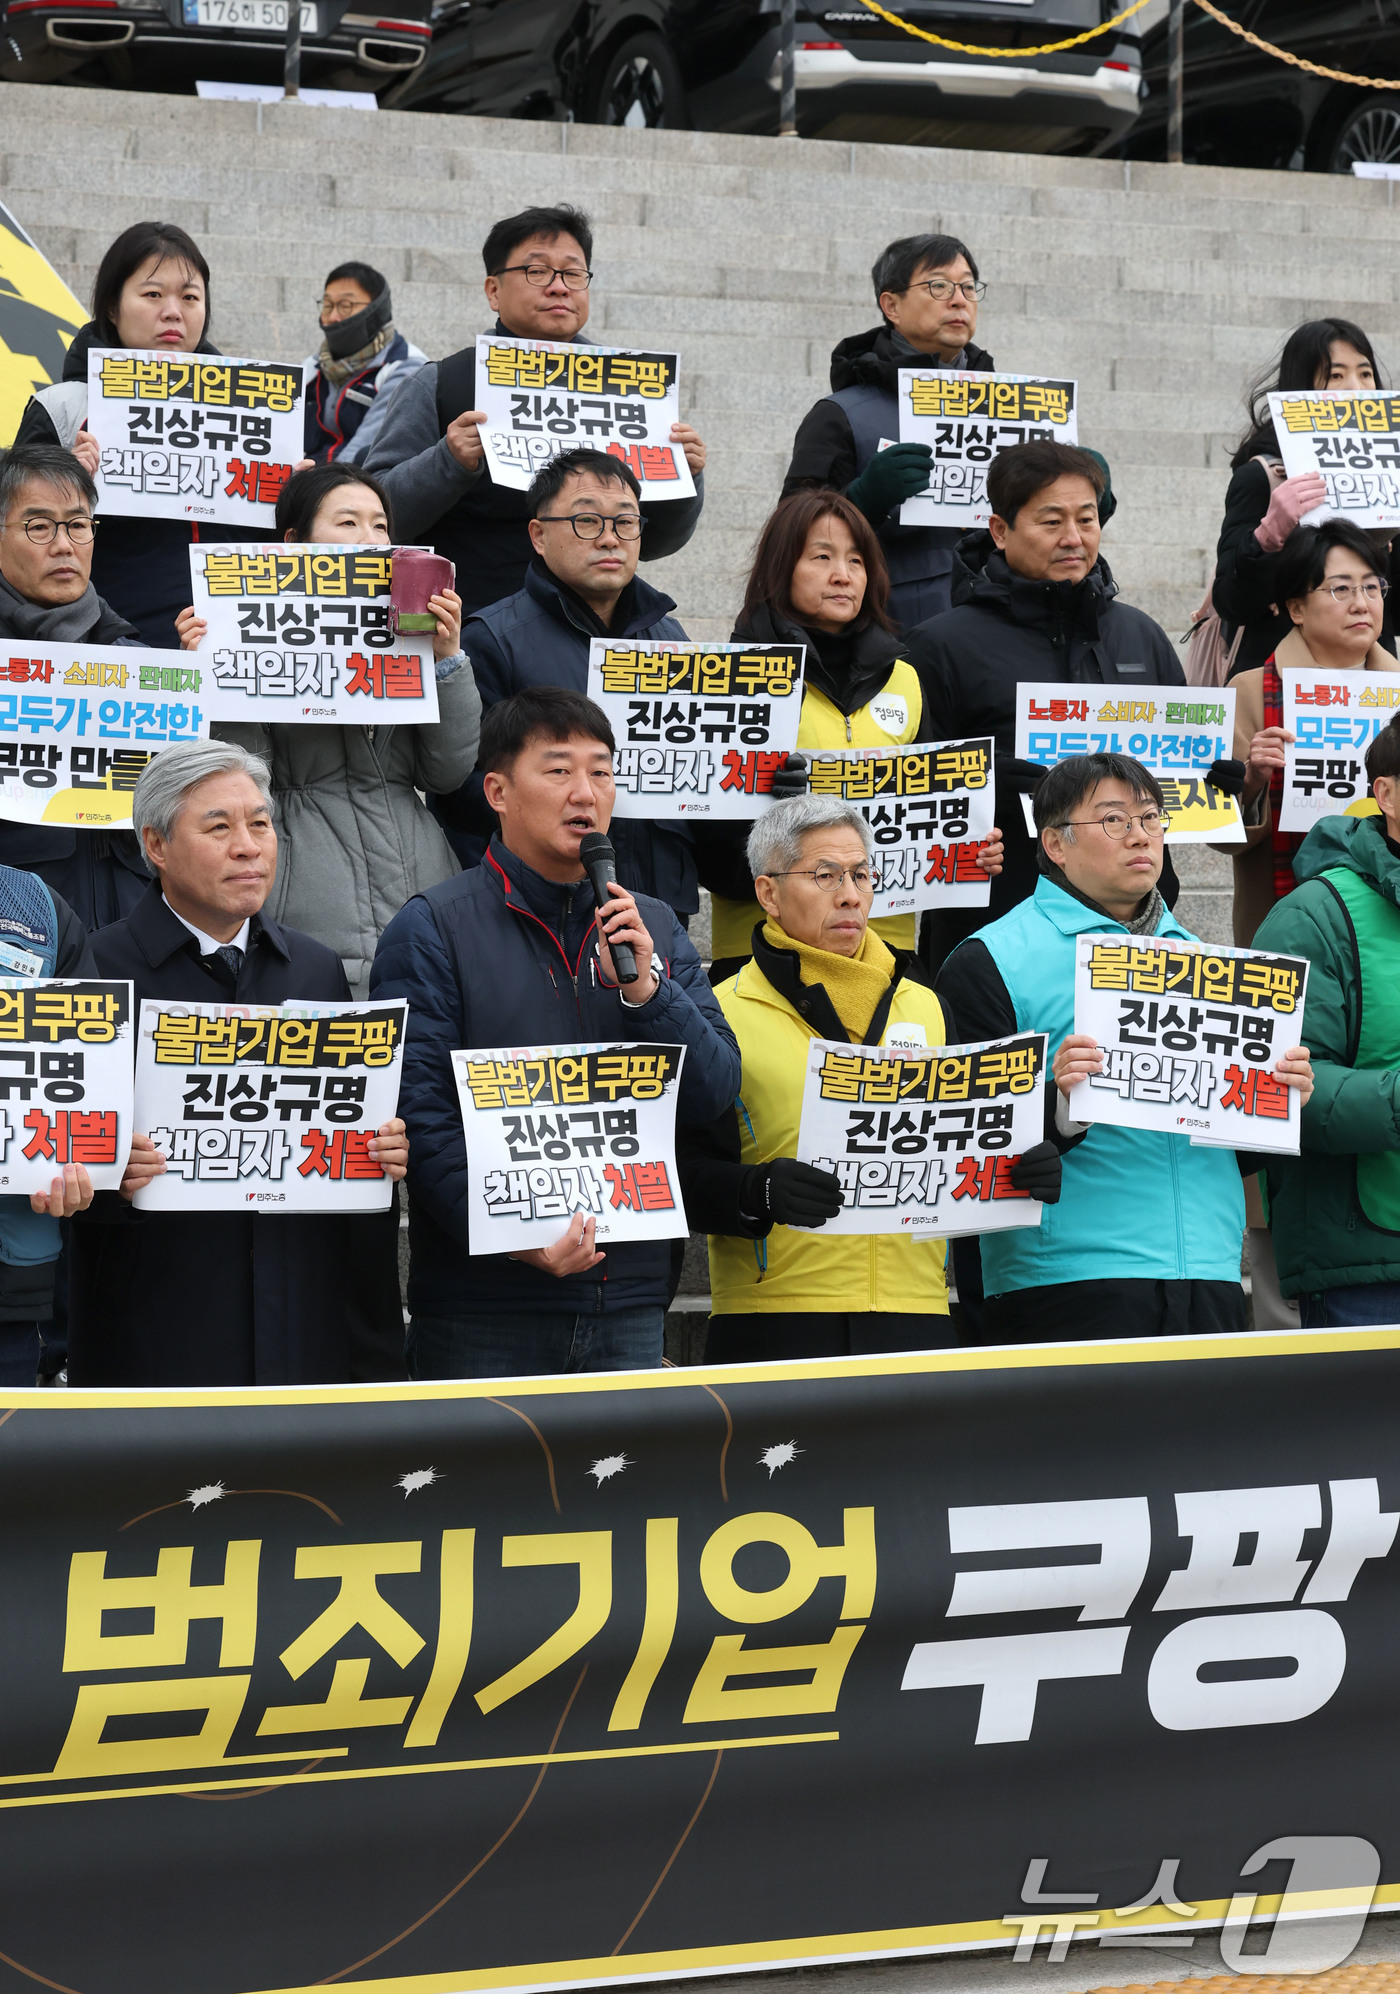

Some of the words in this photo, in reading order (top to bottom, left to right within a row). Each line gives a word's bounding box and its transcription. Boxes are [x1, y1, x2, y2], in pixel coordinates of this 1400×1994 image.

[262, 4, 311, 27] 507
[99, 357, 232, 404] 불법기업
[234, 372, 297, 412] 쿠팡
[486, 345, 604, 394] 불법기업
[607, 358, 670, 400] 쿠팡
[509, 393, 649, 440] 진상규명
[909, 377, 1020, 420] 불법기업
[1022, 385, 1069, 424] 쿠팡
[1281, 400, 1390, 433] 불법기업
[126, 405, 272, 456] 진상규명
[100, 447, 218, 498] 책임자
[224, 457, 294, 504] 처벌
[203, 553, 347, 598] 불법기업
[350, 556, 392, 597] 쿠
[236, 602, 395, 649] 진상규명
[63, 661, 129, 688] 소비자
[139, 666, 202, 693] 판매자
[212, 649, 338, 698] 책임자
[344, 652, 425, 699] 처벌
[600, 649, 732, 695] 불법기업
[735, 653, 797, 697] 쿠팡
[1295, 684, 1350, 706] 노동자
[98, 699, 203, 742] 안전한
[626, 700, 771, 745] 진상규명
[874, 707, 904, 724] 정의당
[1028, 699, 1089, 722] 노동자
[1097, 700, 1157, 723] 소비자
[1165, 702, 1226, 725] 판매자
[1294, 716, 1381, 750] 모두가
[70, 746, 158, 791] 만들
[807, 752, 931, 799] 불법기업
[933, 748, 988, 792] 쿠팡
[1128, 733, 1225, 769] 안전한
[1292, 758, 1361, 799] 쿠팡
[860, 797, 970, 844] 상규명
[924, 840, 991, 885] 처벌
[1088, 944, 1236, 1003] 불법기업
[1238, 962, 1299, 1013] 쿠팡
[31, 992, 120, 1043] 쿠팡
[153, 1013, 319, 1067] 불법기업
[322, 1018, 398, 1068] 쿠팡
[1117, 999, 1275, 1062] 진상규명
[182, 1073, 368, 1123] 진상규명
[466, 1056, 590, 1109] 불법기업
[594, 1055, 671, 1100] 쿠팡
[819, 1051, 972, 1103] 불법기업
[975, 1047, 1038, 1098] 쿠팡
[1089, 1046, 1217, 1108] 책임자
[1219, 1064, 1289, 1120] 처벌
[21, 1108, 118, 1163] 처벌
[501, 1109, 640, 1162] 진상규명
[845, 1103, 1014, 1155] 진상규명
[149, 1127, 290, 1180] 책임자
[297, 1128, 386, 1180] 처벌
[257, 1192, 286, 1201] 민주노총
[483, 1165, 602, 1220] 책임자
[602, 1161, 676, 1212] 처벌
[912, 1216, 938, 1225] 민주노총
[52, 1506, 878, 1776] 범죄기업
[900, 1478, 1400, 1745] 쿠팡
